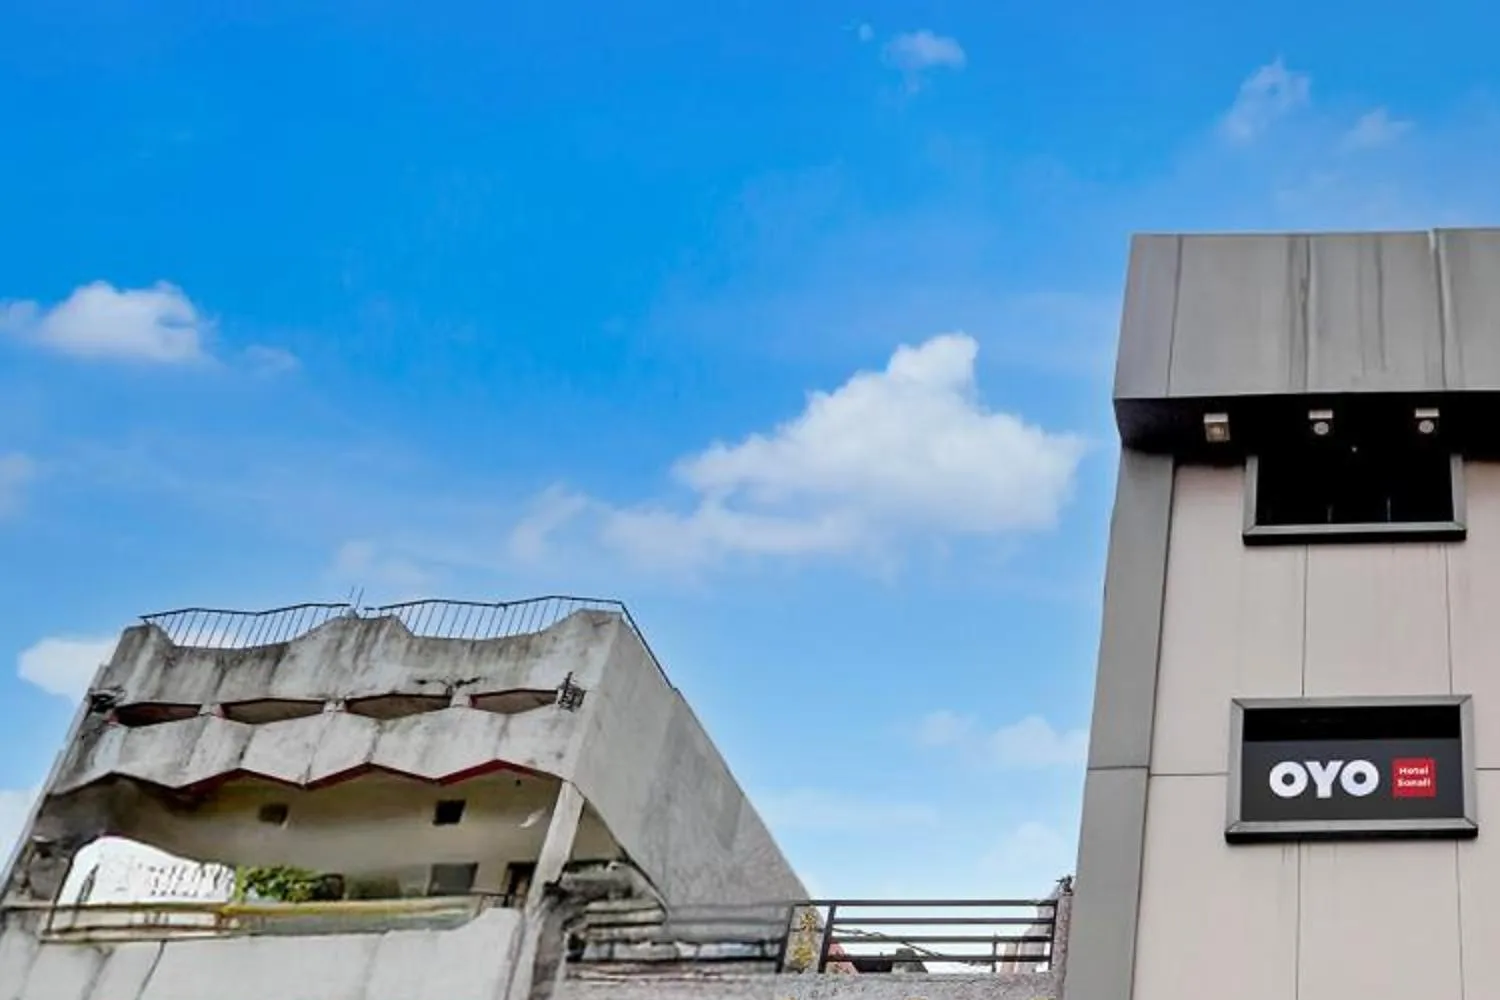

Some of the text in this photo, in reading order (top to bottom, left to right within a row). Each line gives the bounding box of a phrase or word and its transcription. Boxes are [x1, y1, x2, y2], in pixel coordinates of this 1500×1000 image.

[1399, 765, 1429, 775] Hotel
[1269, 759, 1380, 798] OYO
[1397, 778, 1431, 787] Sonali
